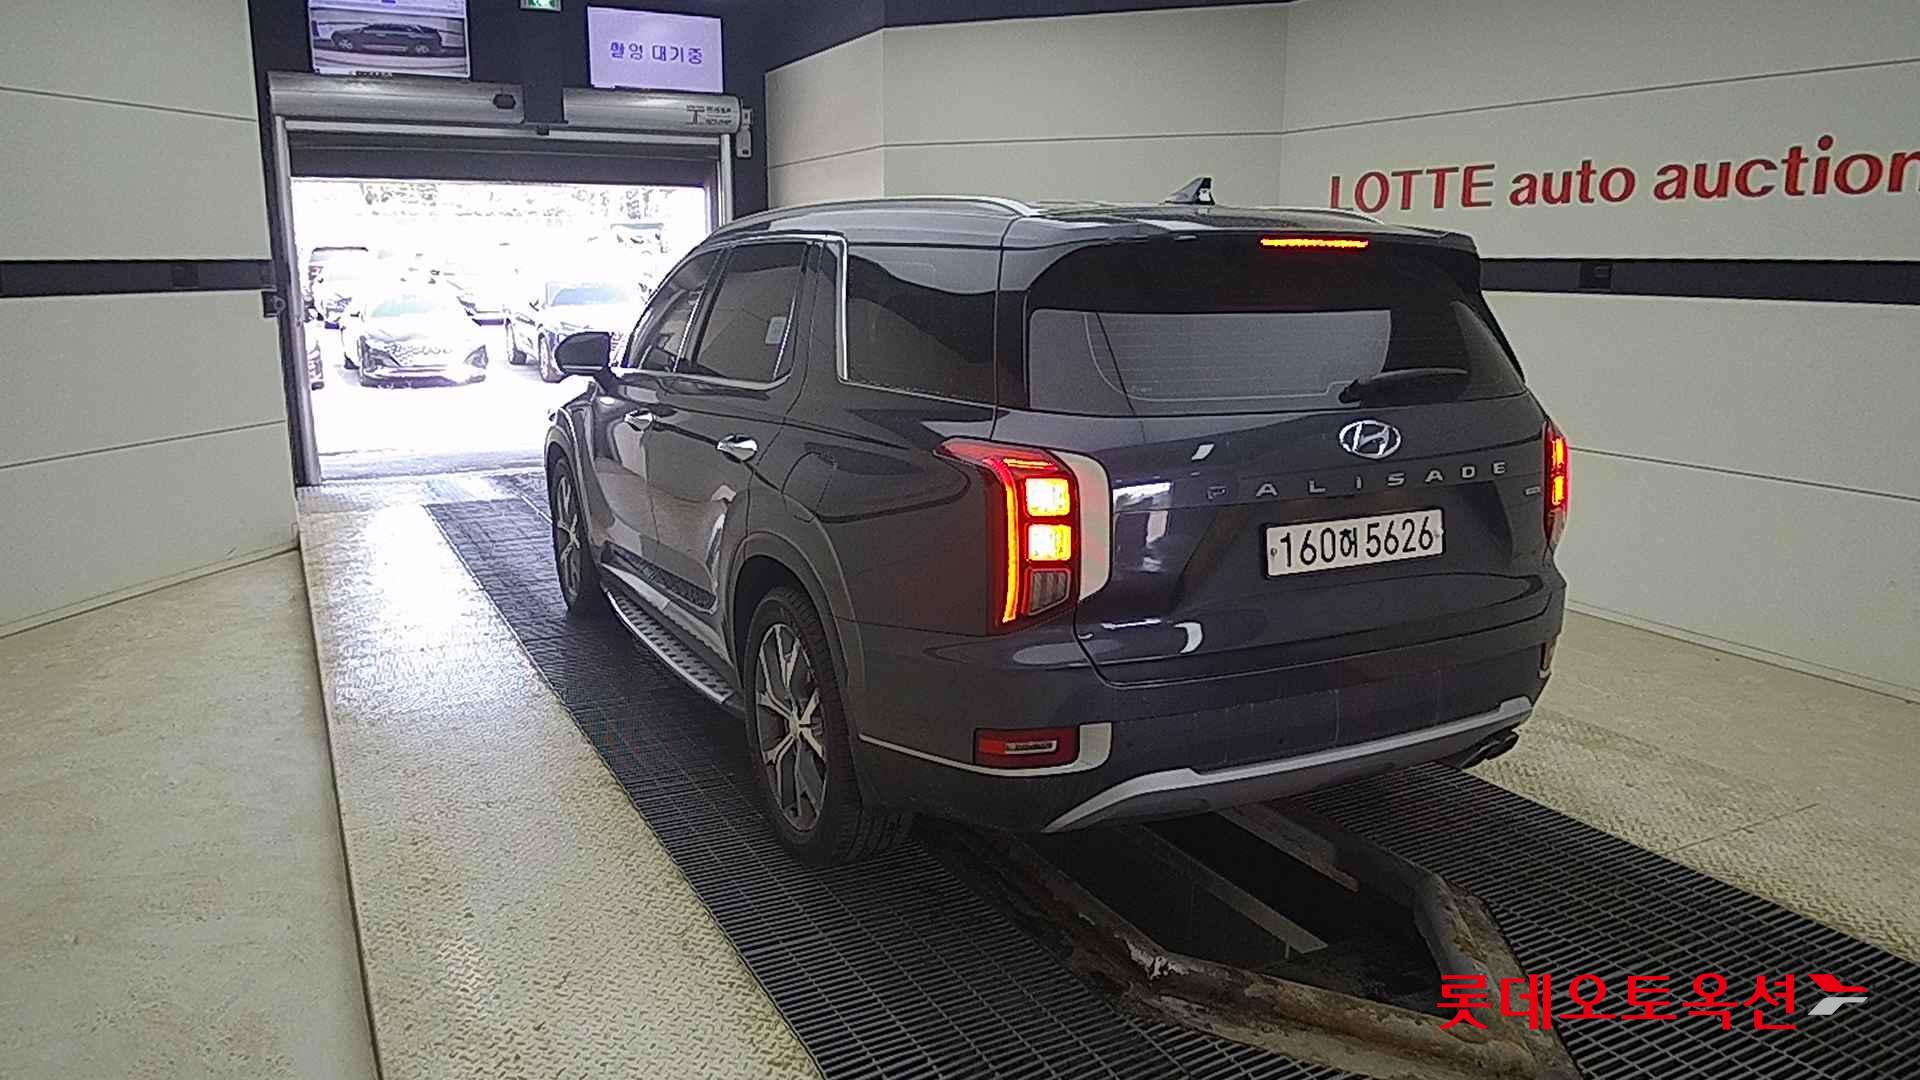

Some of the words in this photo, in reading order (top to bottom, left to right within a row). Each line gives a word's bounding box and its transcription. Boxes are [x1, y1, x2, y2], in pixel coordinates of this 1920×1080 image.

[651, 44, 703, 65] 대기중
[1329, 163, 1496, 214] LOTTE
[1509, 158, 1636, 206] auto
[1206, 461, 1507, 500] PALISADE
